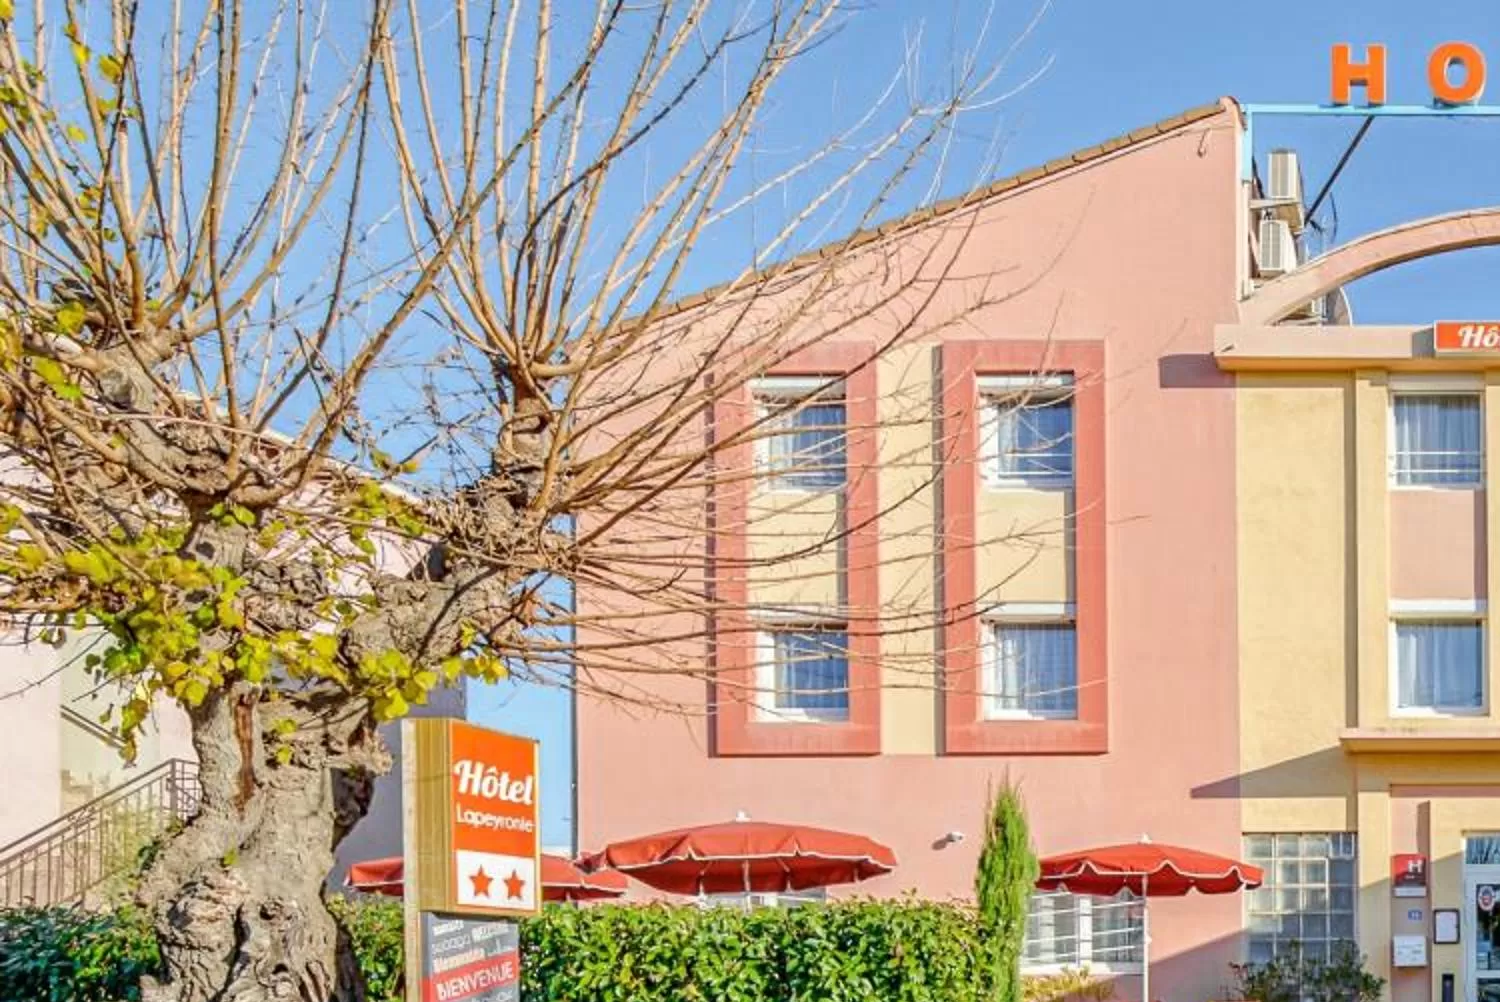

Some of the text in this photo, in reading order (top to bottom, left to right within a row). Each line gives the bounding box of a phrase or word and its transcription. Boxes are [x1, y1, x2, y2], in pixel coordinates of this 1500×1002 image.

[454, 759, 533, 806] Hôtel
[456, 801, 533, 833] Lapeyronie
[1407, 859, 1423, 873] H
[436, 961, 514, 1000] BIENVENUE
